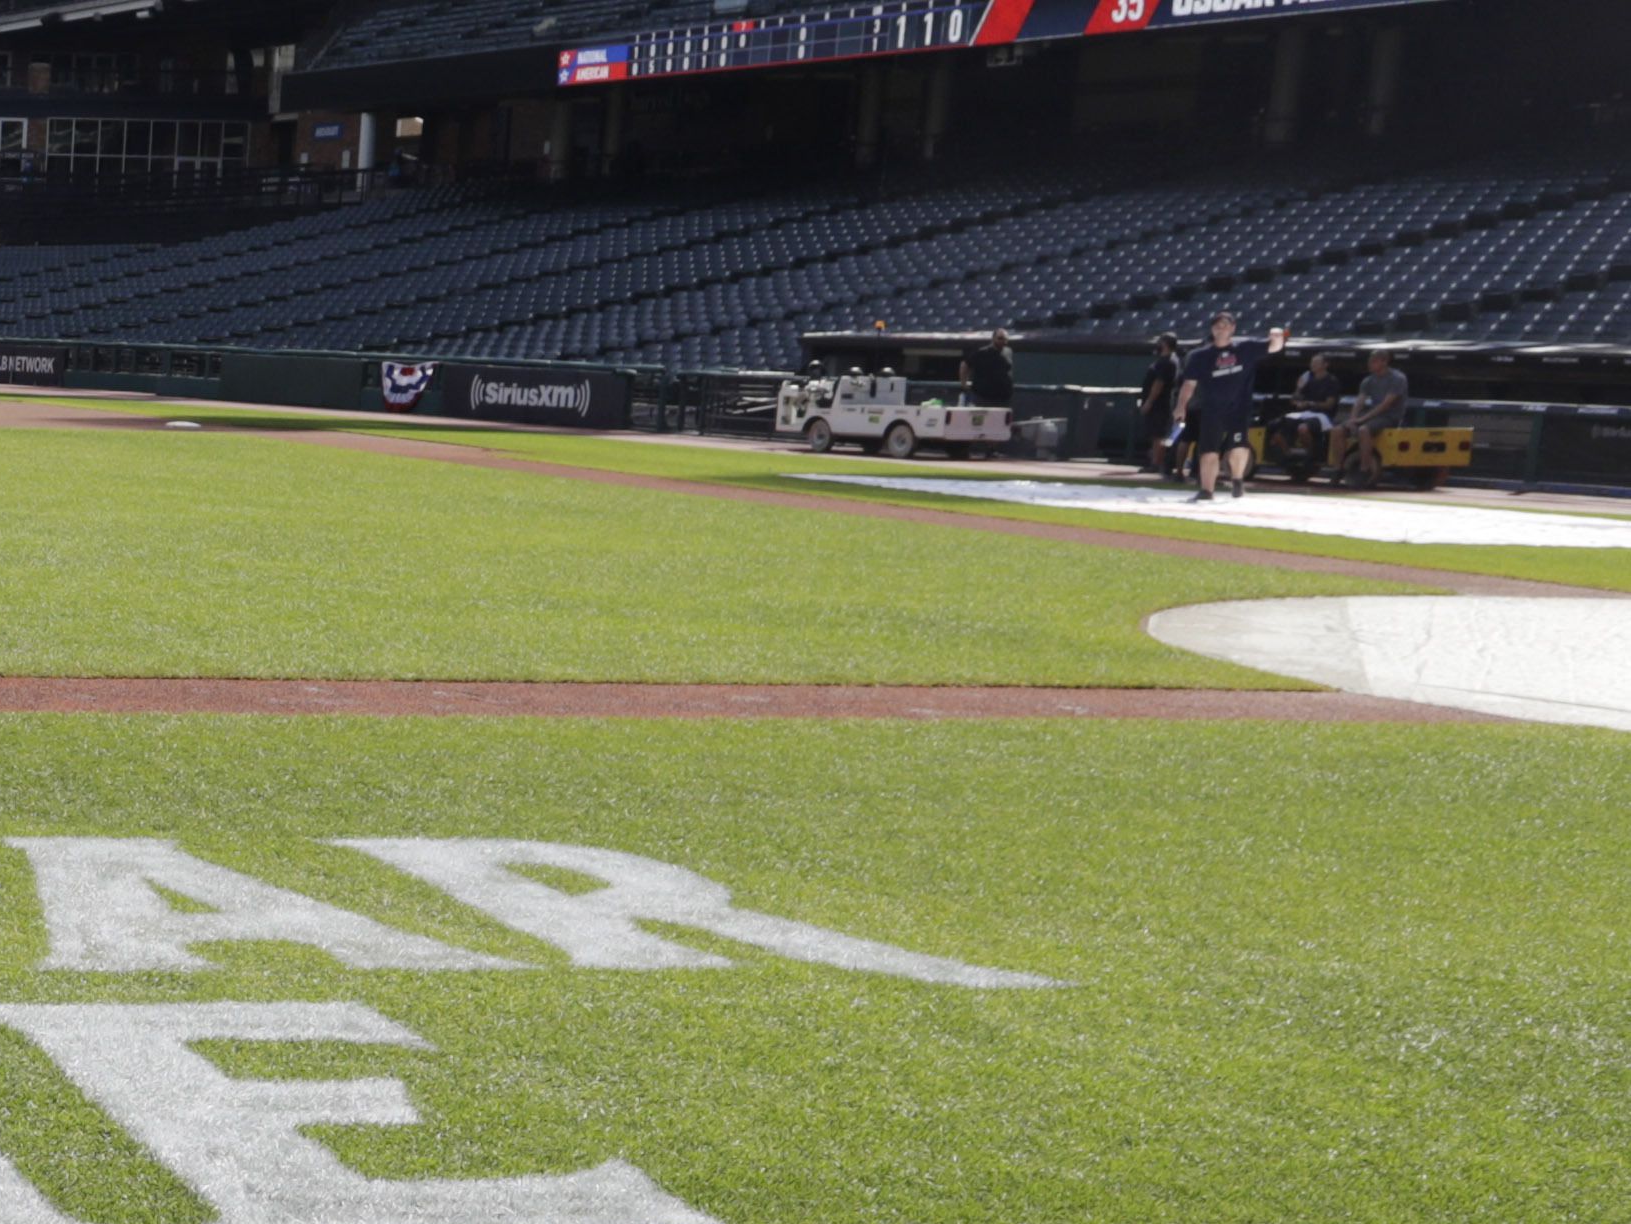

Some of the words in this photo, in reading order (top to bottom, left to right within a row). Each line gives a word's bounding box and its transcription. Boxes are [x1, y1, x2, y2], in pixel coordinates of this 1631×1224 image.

[897, 16, 906, 48] 1
[924, 13, 933, 45] 1
[948, 9, 962, 42] 0
[8, 355, 54, 374] NETWORK
